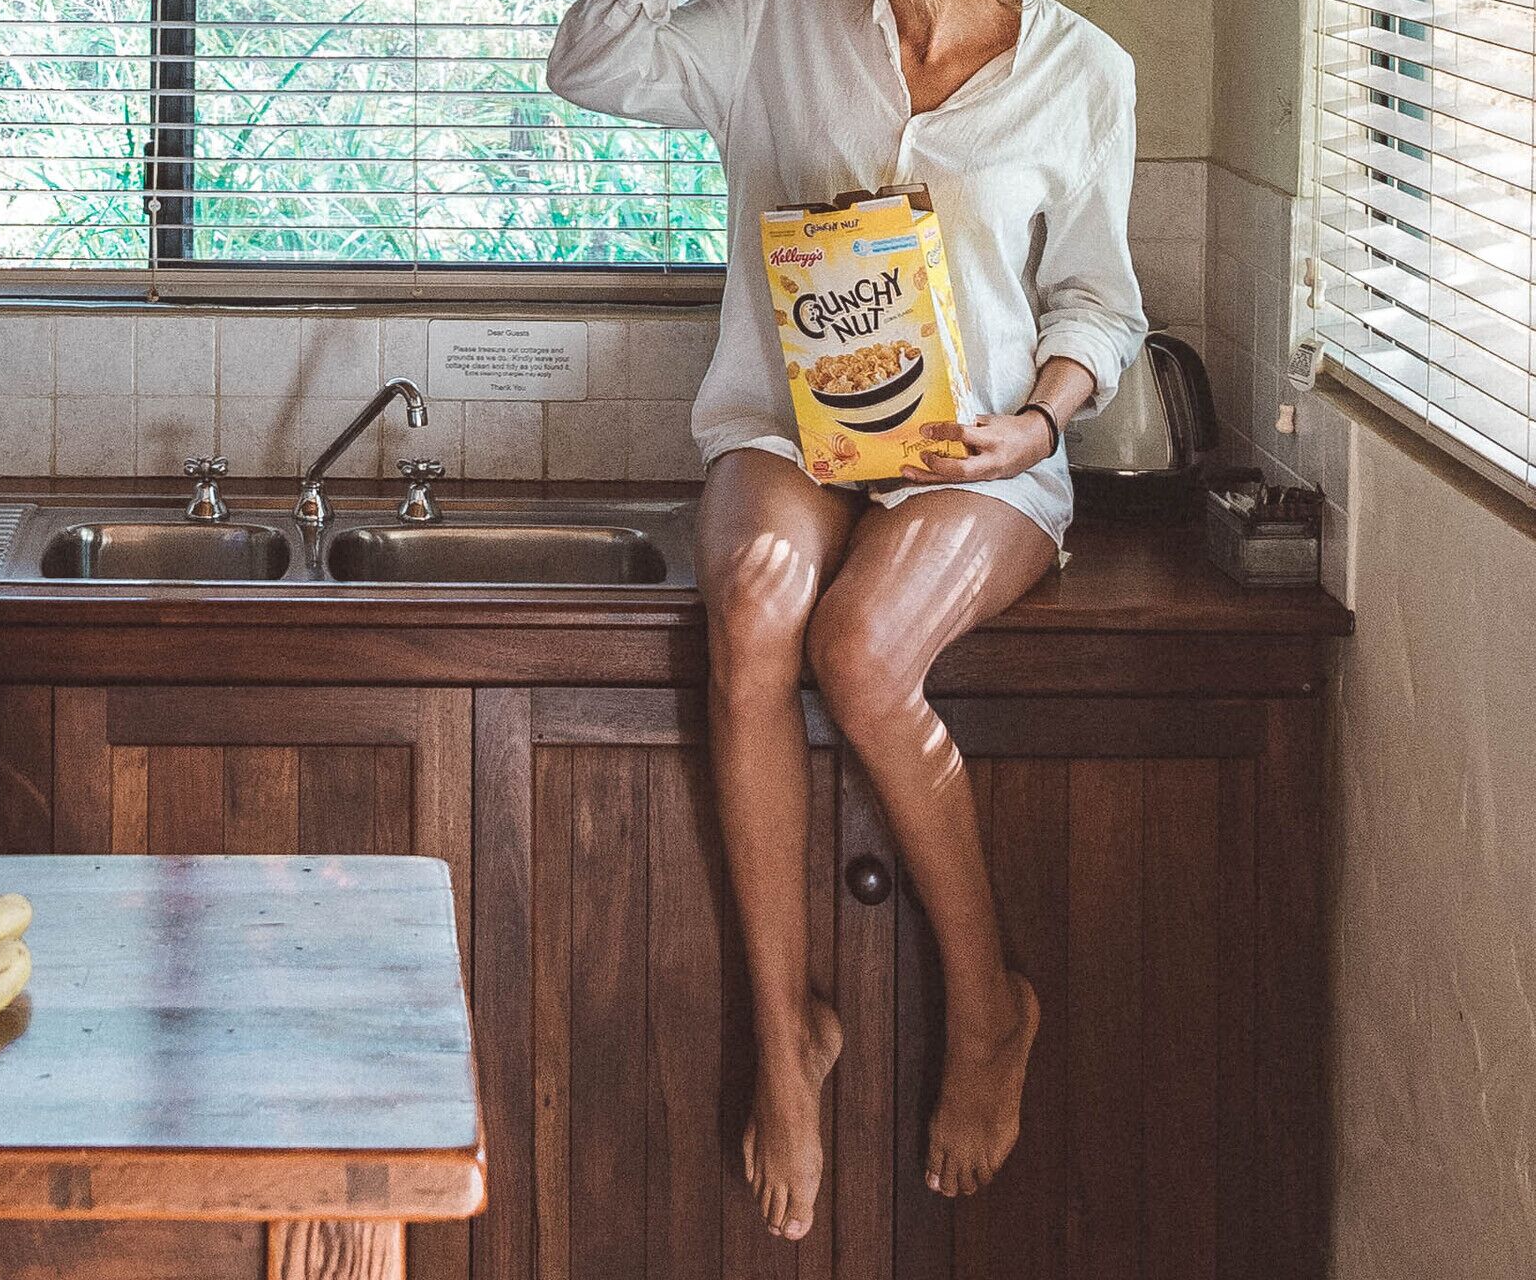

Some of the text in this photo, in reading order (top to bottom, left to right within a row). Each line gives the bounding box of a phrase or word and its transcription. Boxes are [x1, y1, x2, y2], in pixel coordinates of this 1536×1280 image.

[840, 219, 860, 230] NUT
[770, 247, 823, 268] Kellogg's
[792, 267, 902, 339] CRUNCHY
[831, 307, 884, 343] NUT
[487, 329, 529, 337] Dear Guests
[453, 345, 477, 353] Please
[520, 347, 549, 355] cottages
[512, 354, 534, 363] Kindly
[490, 383, 512, 391] Thank
